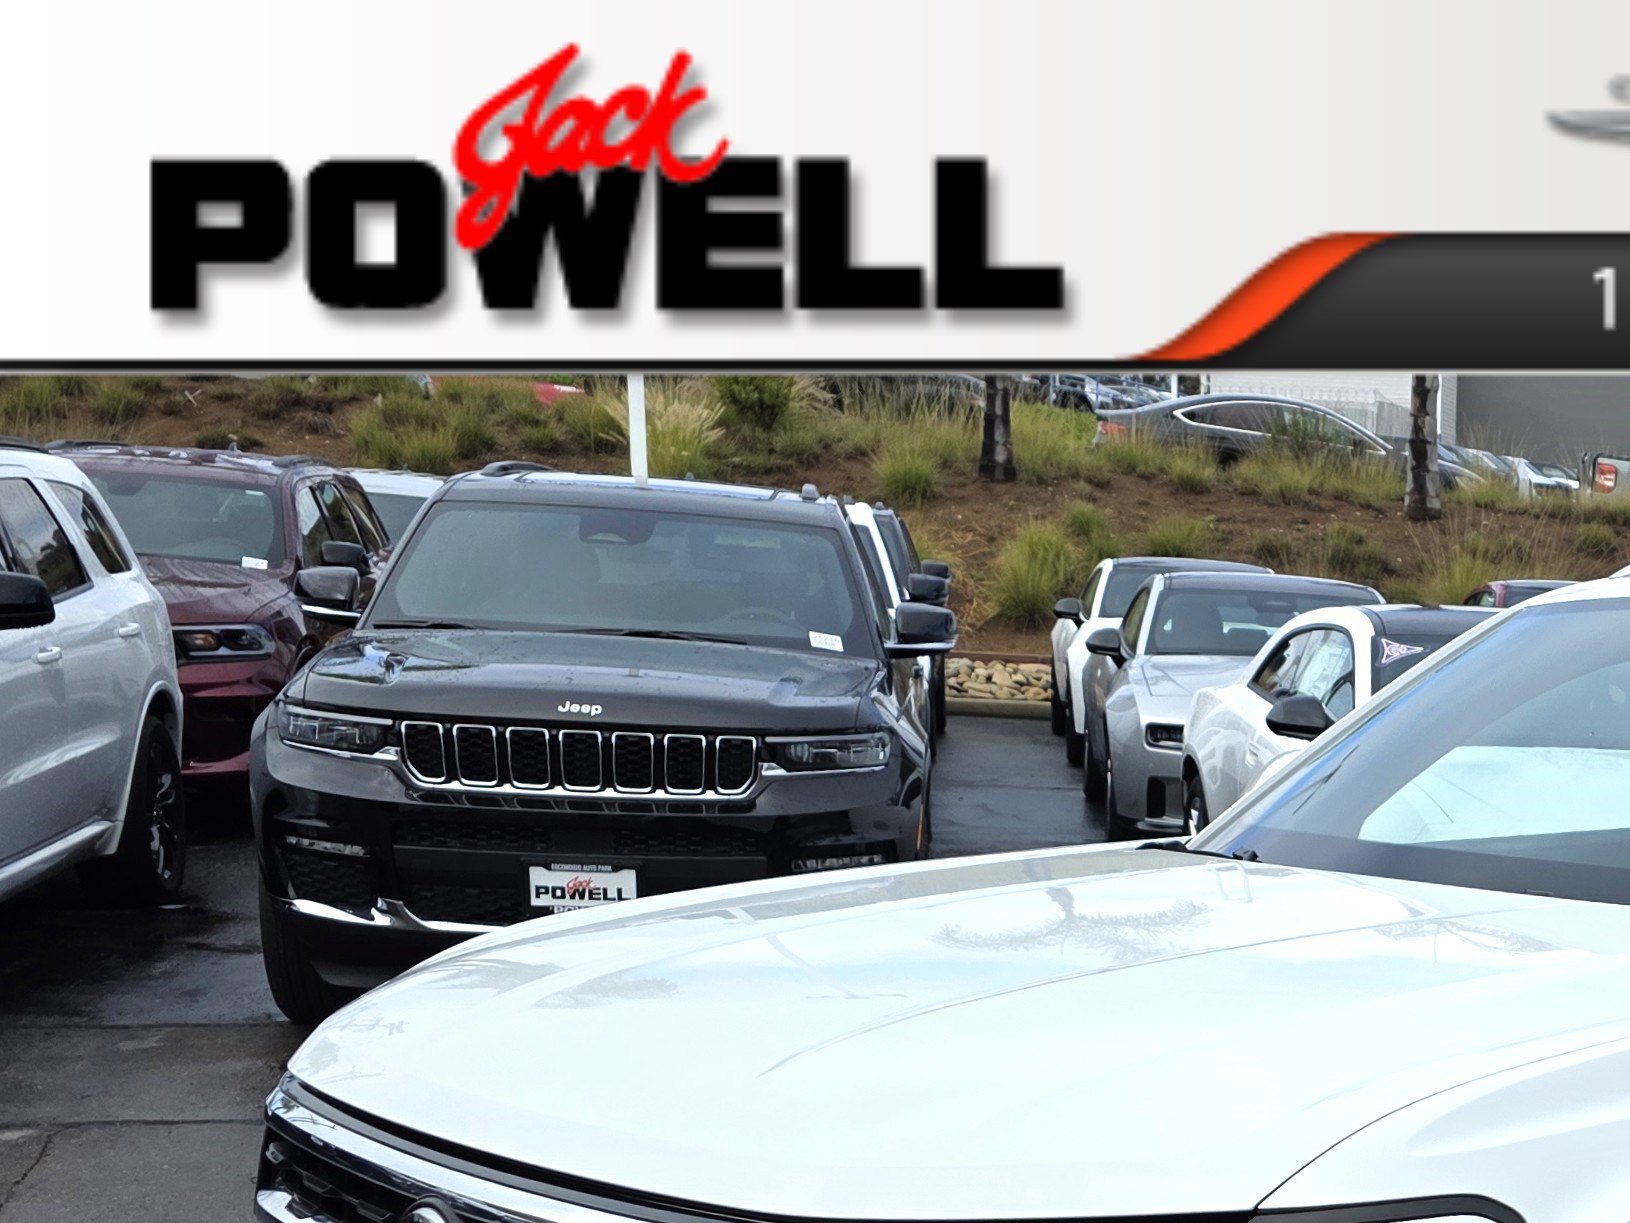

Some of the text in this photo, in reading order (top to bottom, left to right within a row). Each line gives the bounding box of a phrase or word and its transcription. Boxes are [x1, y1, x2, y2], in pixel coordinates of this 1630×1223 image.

[557, 700, 603, 717] Jeep
[583, 864, 597, 872] AUTO
[534, 885, 632, 900] POWELL
